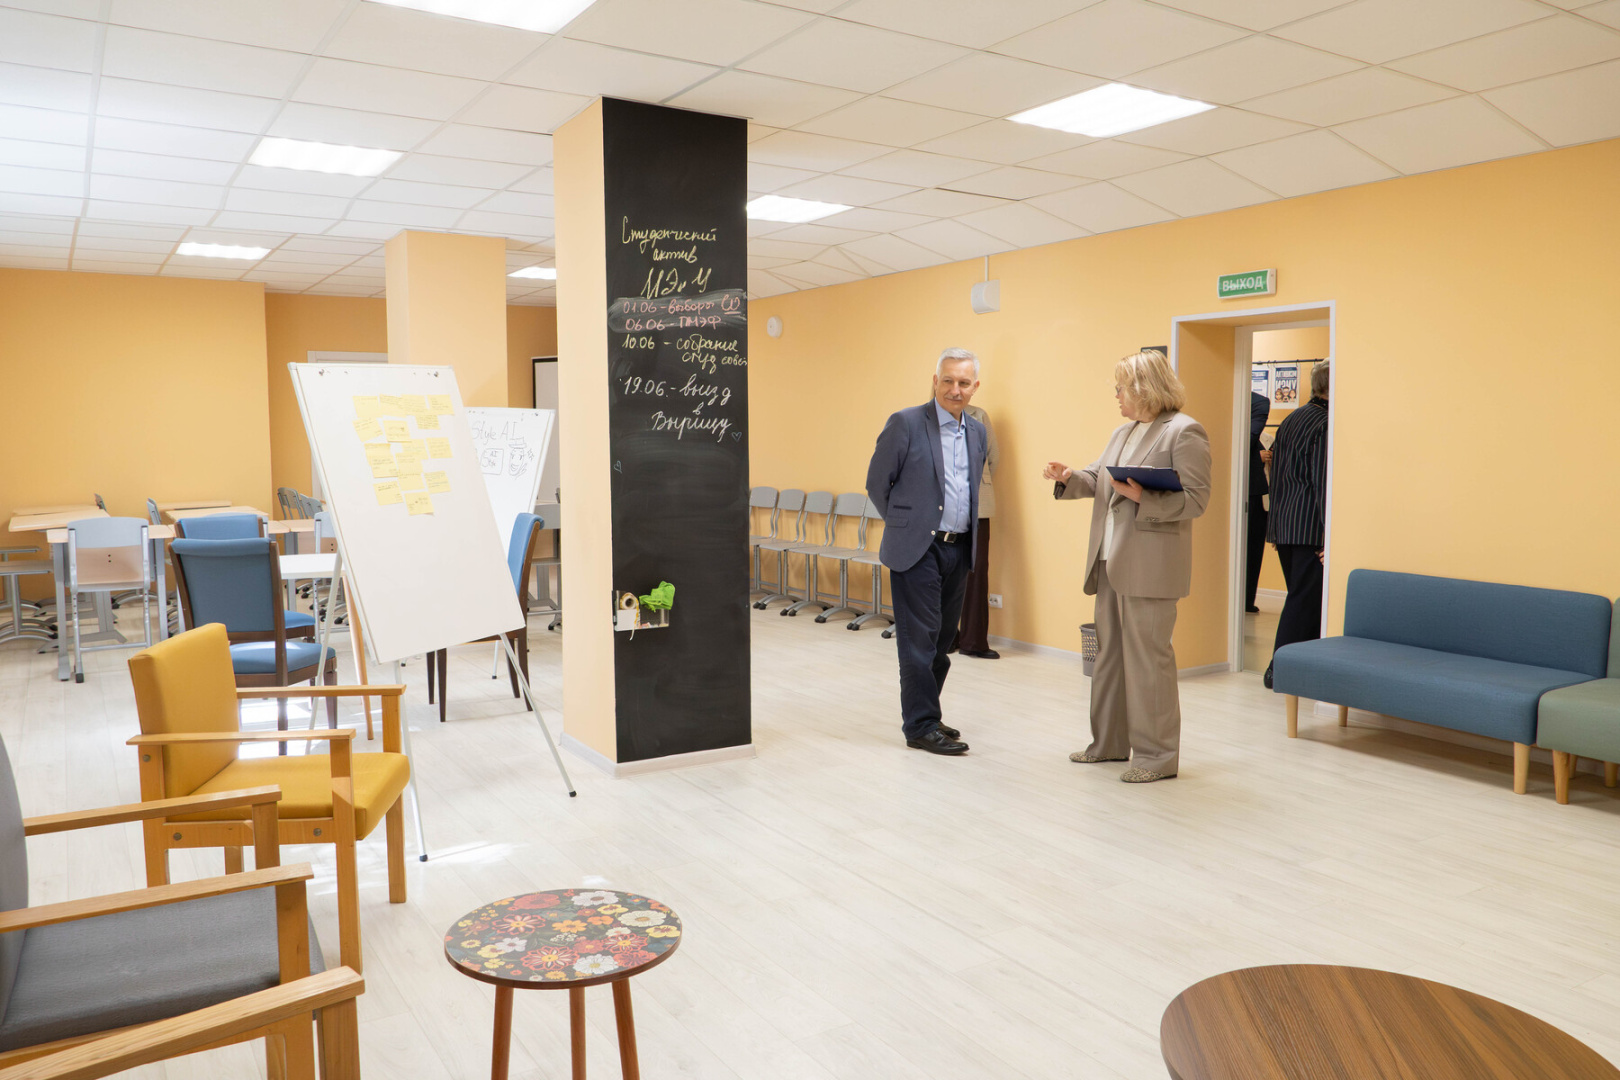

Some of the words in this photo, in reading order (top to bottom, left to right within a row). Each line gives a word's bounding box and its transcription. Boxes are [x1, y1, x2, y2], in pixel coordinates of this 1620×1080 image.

[652, 245, 697, 263] актив
[1222, 275, 1264, 292] ВЫХОД
[678, 315, 722, 330] ПМЭФ
[622, 333, 656, 350] 10.06
[676, 333, 739, 354] собрание
[692, 401, 705, 416] в
